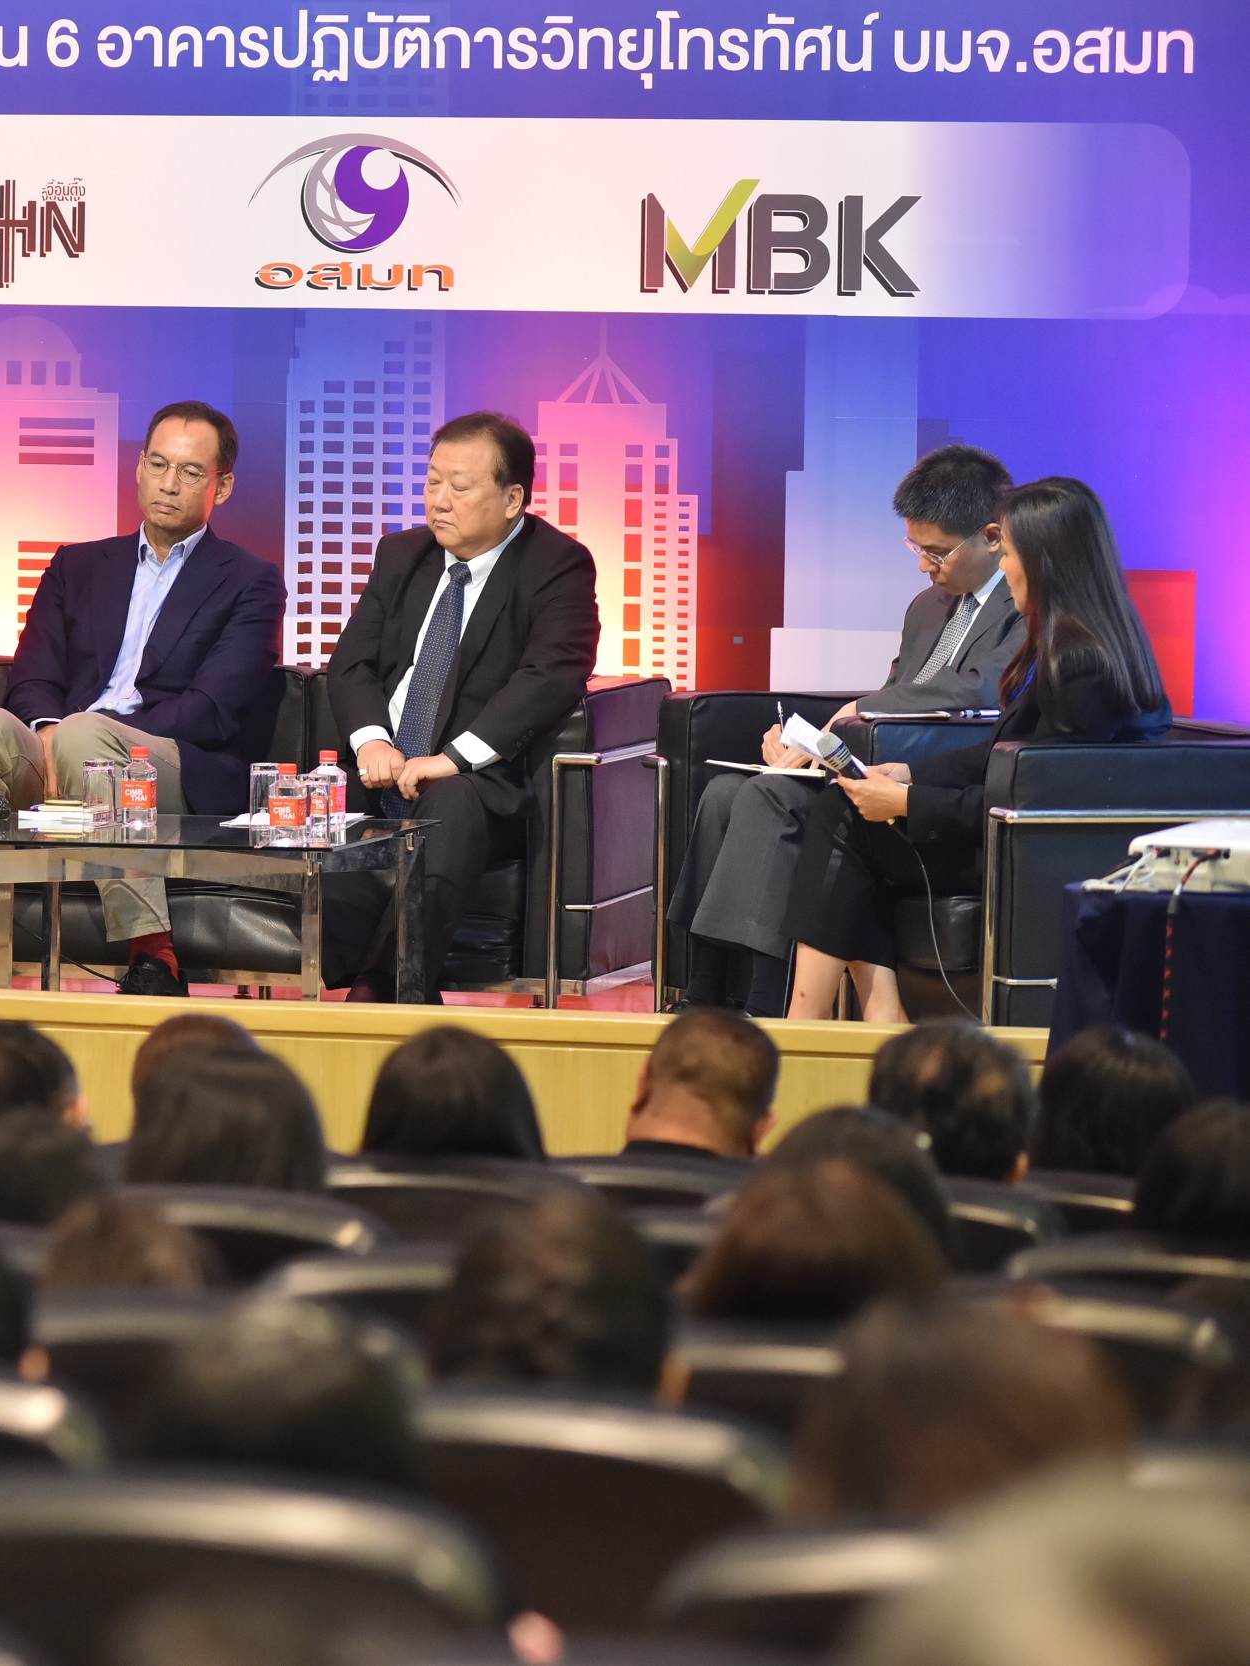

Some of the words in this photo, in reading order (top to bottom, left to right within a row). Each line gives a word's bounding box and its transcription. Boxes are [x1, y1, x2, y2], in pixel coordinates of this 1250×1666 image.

[46, 18, 80, 68] 6
[97, 9, 880, 89] อาคารปฏิบัติการวิทยุโทรทัศน์
[894, 26, 1194, 74] บมจ.อสมท
[640, 178, 923, 298] MBK
[255, 262, 455, 291] อสมท
[124, 788, 143, 796] CIMB
[273, 806, 291, 814] CIMB
[278, 812, 295, 820] THAI
